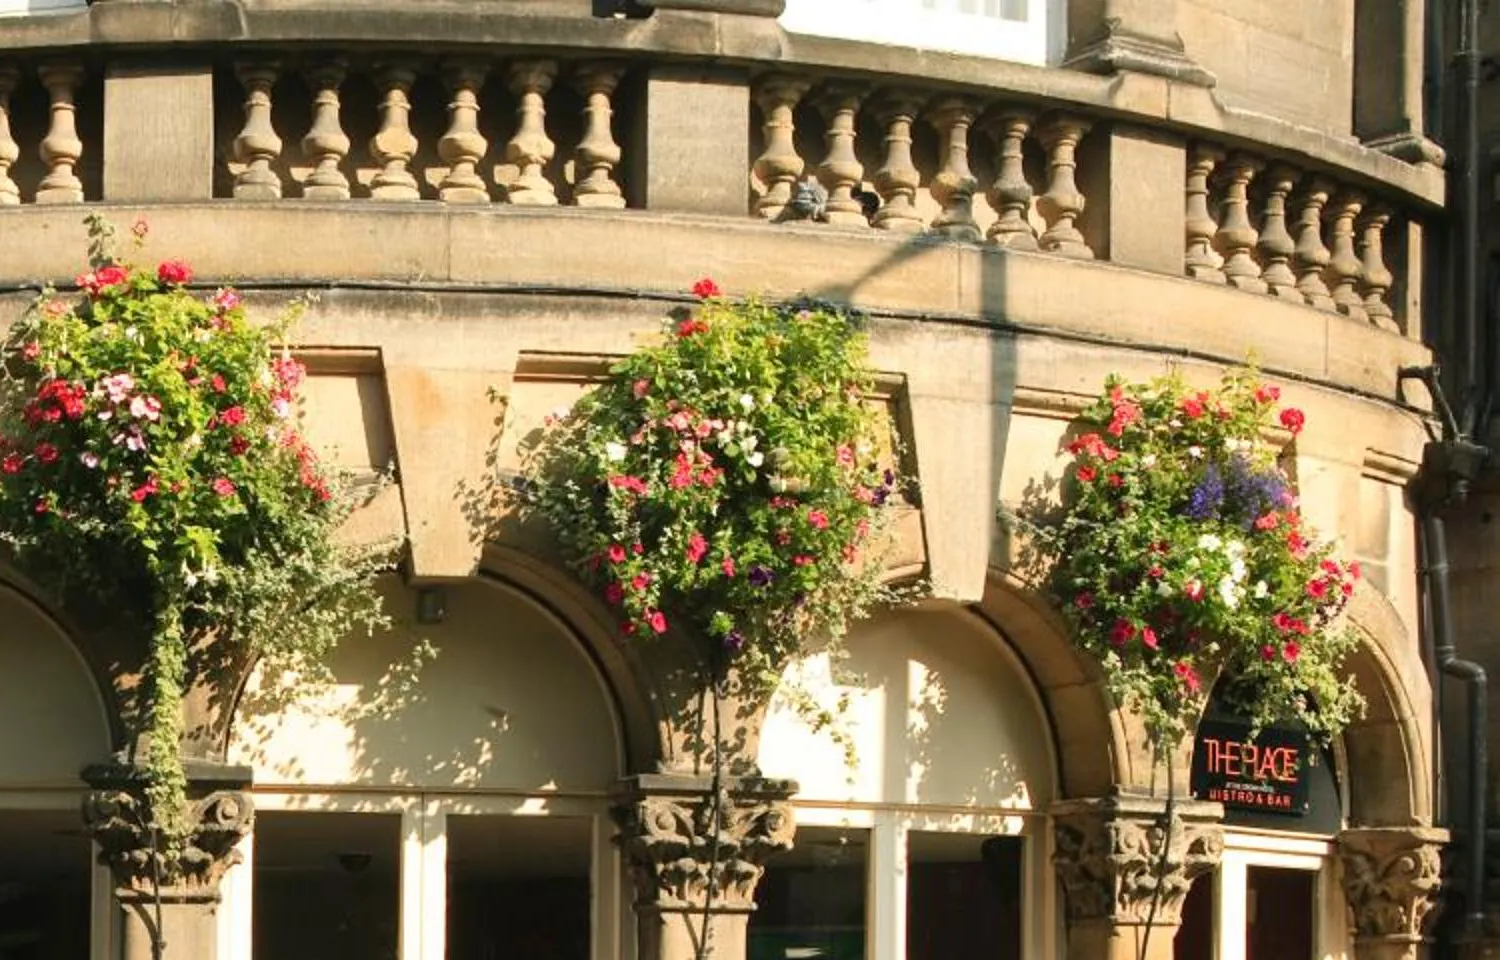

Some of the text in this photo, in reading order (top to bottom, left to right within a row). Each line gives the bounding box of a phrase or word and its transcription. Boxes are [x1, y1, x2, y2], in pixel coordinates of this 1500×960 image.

[1203, 739, 1299, 782] THE PLACE
[1267, 794, 1292, 807] BAR
